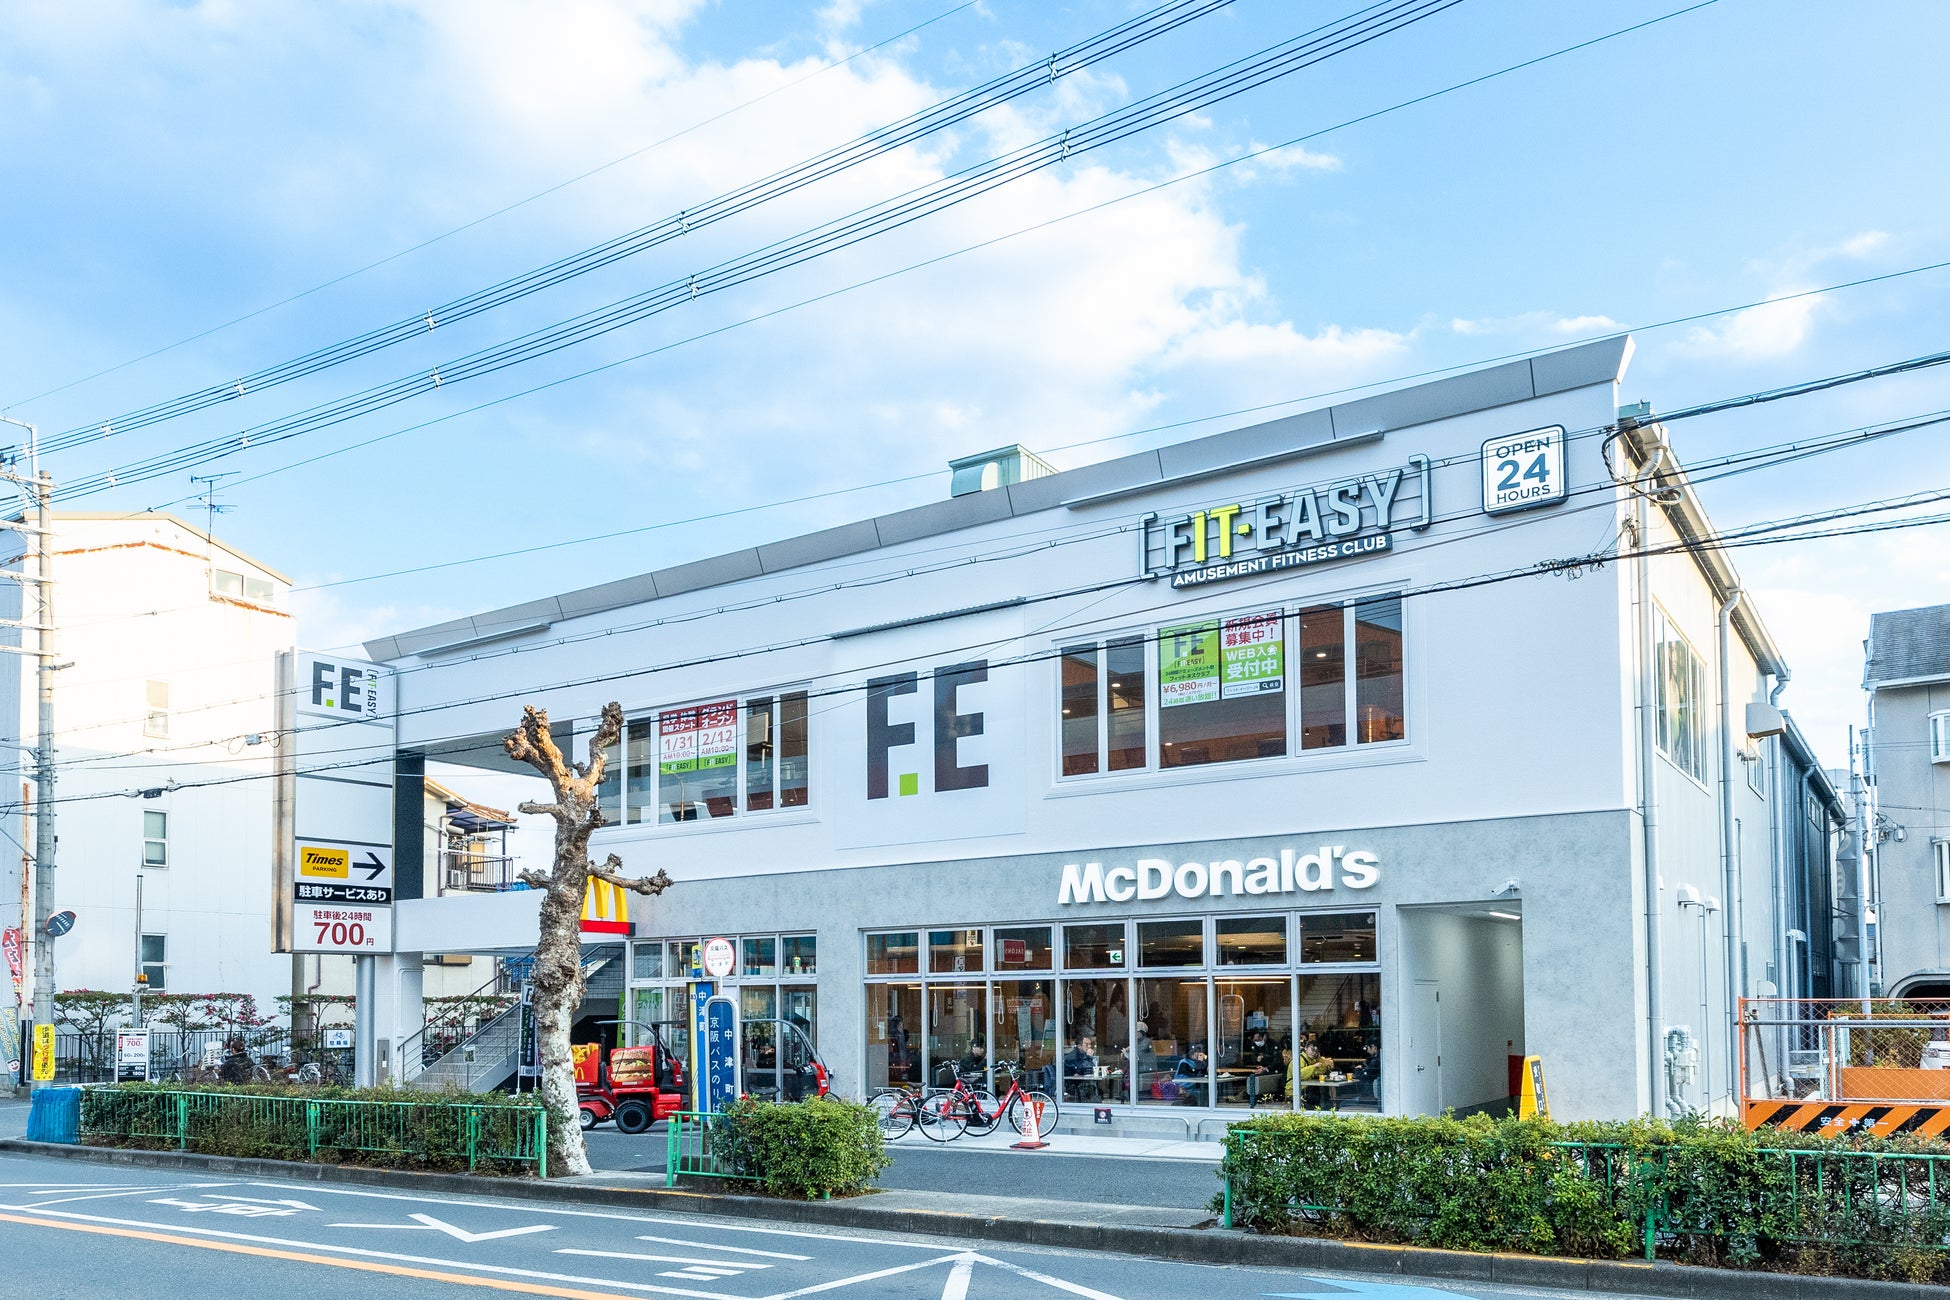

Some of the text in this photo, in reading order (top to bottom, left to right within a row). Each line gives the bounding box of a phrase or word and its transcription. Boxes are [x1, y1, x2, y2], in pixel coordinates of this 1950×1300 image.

[1496, 436, 1550, 459] OPEN
[1497, 453, 1550, 492] 24
[1497, 484, 1551, 504] HOURS
[1173, 535, 1387, 587] AMUSEMENT FITNESS CLUB
[1226, 645, 1278, 661] WEB入会
[1227, 657, 1278, 680] 受付中
[312, 661, 363, 712] F.E
[701, 715, 734, 728] オープン
[867, 659, 989, 800] F.E
[665, 735, 693, 751] 1/31
[702, 729, 733, 746] 2/12
[306, 852, 344, 866] Times
[1057, 845, 1381, 905] McDonald's
[299, 885, 387, 901] 駐車サービスあり
[313, 910, 372, 921] 駐車後24時間
[724, 1028, 735, 1096] 中津町
